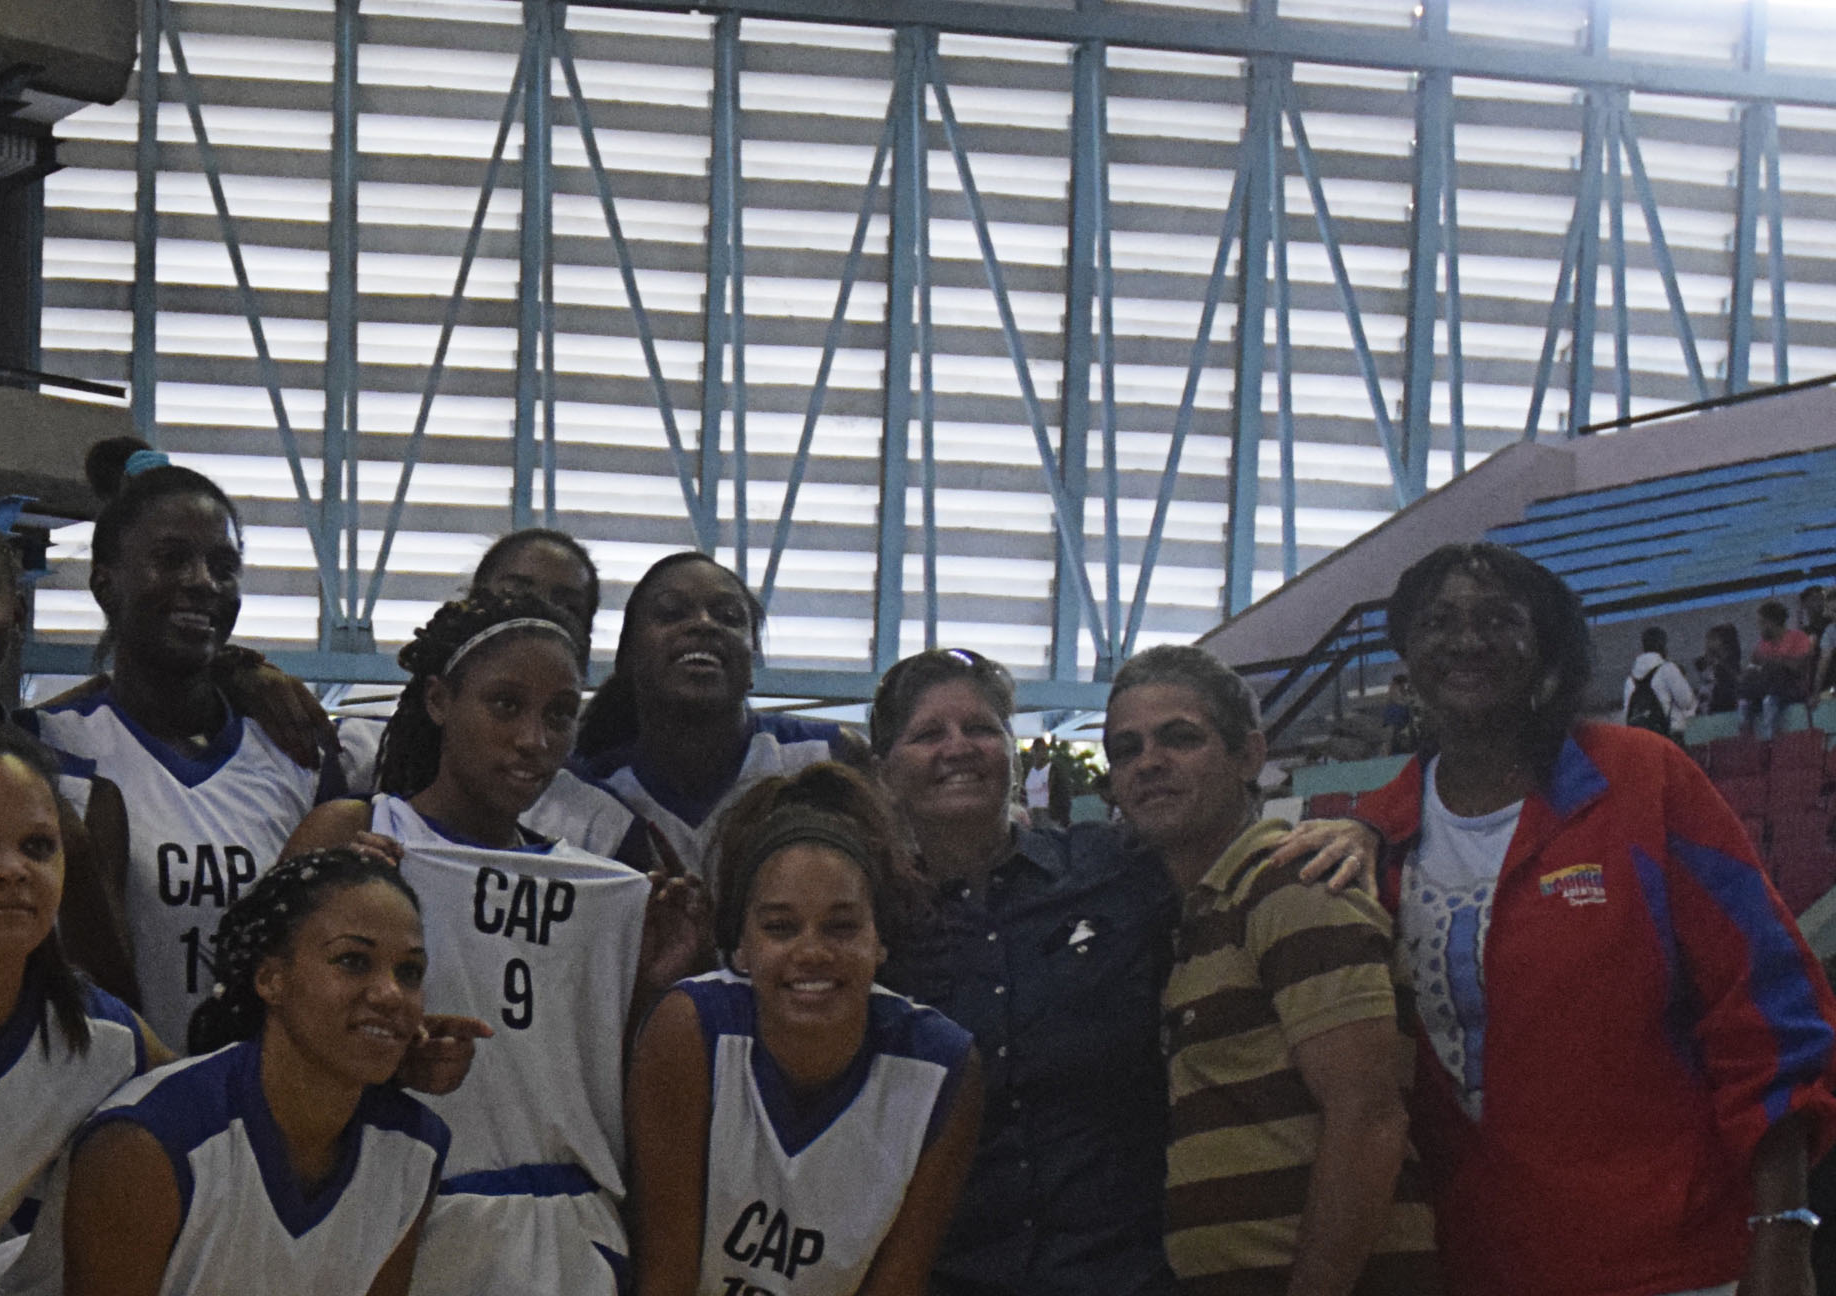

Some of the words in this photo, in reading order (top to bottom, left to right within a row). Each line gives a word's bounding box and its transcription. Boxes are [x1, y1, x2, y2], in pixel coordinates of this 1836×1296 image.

[157, 842, 257, 907] CAP
[473, 866, 576, 946] CAP
[179, 926, 220, 994] 1
[501, 957, 533, 1030] 9
[723, 1199, 825, 1281] CAP
